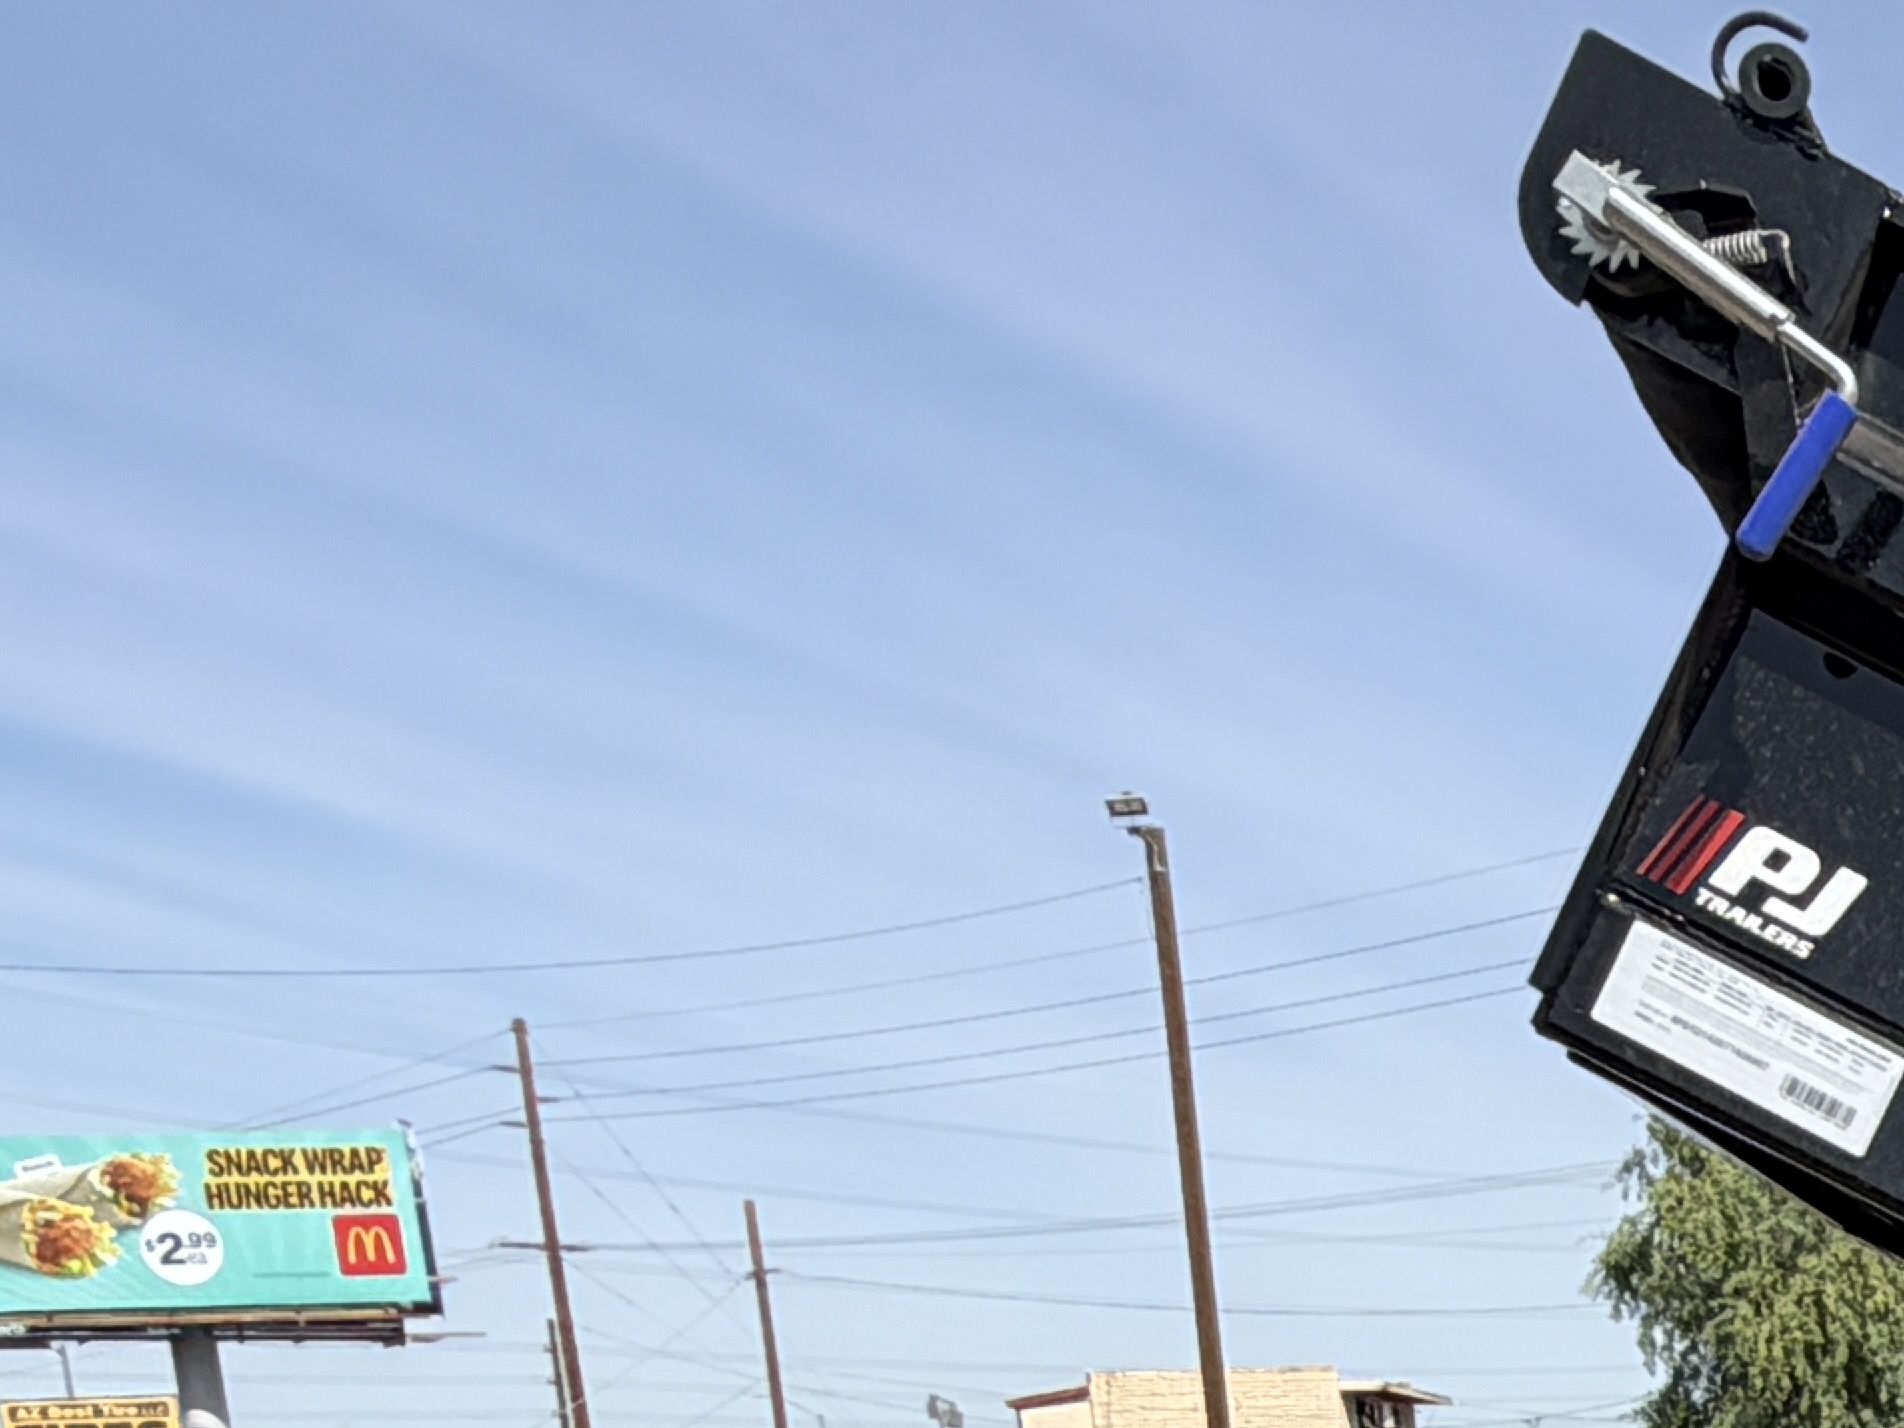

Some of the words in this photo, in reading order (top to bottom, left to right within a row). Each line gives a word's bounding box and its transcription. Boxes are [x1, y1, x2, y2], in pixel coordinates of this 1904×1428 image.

[1707, 825, 1868, 936] PJ
[1695, 887, 1816, 959] TRAILERS
[206, 1147, 298, 1178] SNACK
[301, 1146, 386, 1175] WRAP
[205, 1181, 313, 1211] HUNGER
[316, 1179, 393, 1208] HACK
